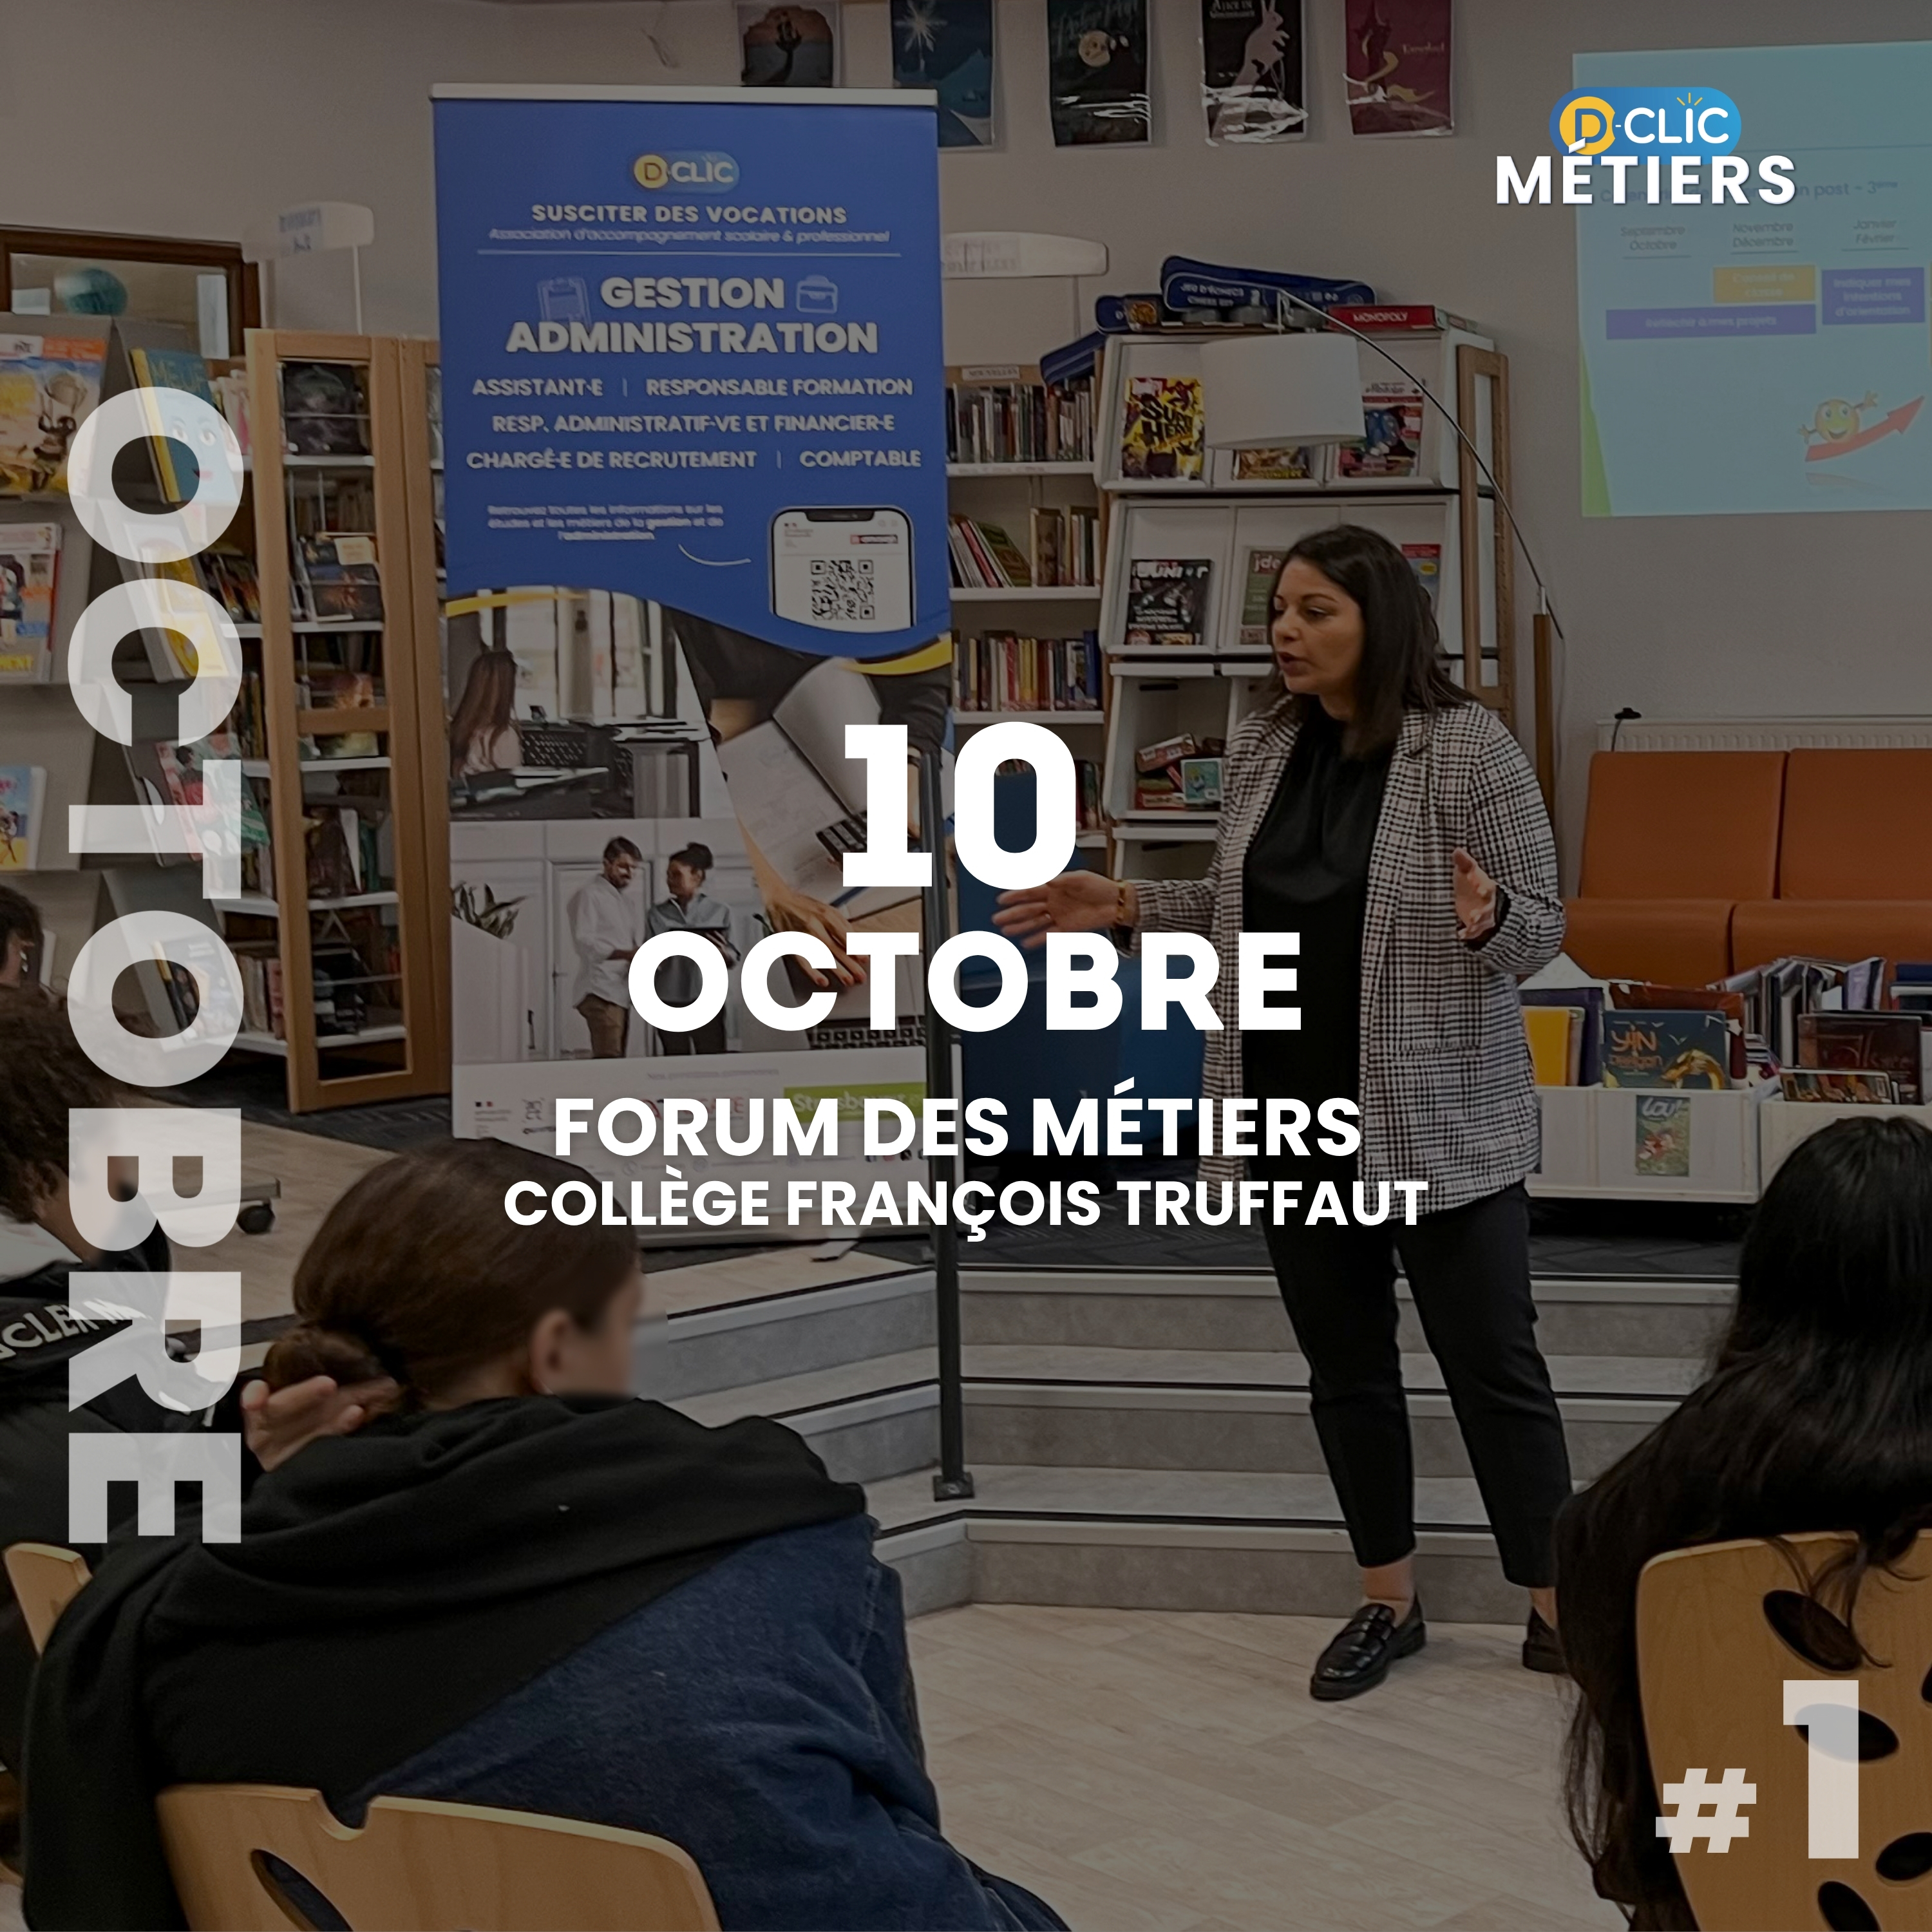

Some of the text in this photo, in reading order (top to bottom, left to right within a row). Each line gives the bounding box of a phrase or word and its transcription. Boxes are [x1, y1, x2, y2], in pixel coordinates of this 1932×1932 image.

[1814, 182, 1850, 200] post
[532, 204, 848, 224] SUSCITER DES VOCATIONS
[601, 277, 785, 309] GESTION
[1353, 312, 1408, 323] MONOPOLY
[506, 321, 878, 354] ADMINISTRATION
[646, 378, 788, 397] RESPONSABLE
[792, 378, 913, 396] FORMATION
[493, 414, 551, 433] RESP.
[746, 415, 770, 432] ET
[576, 450, 604, 469] DE
[609, 450, 757, 469] RECRUTEMENT
[799, 450, 921, 468] COMPTABLE
